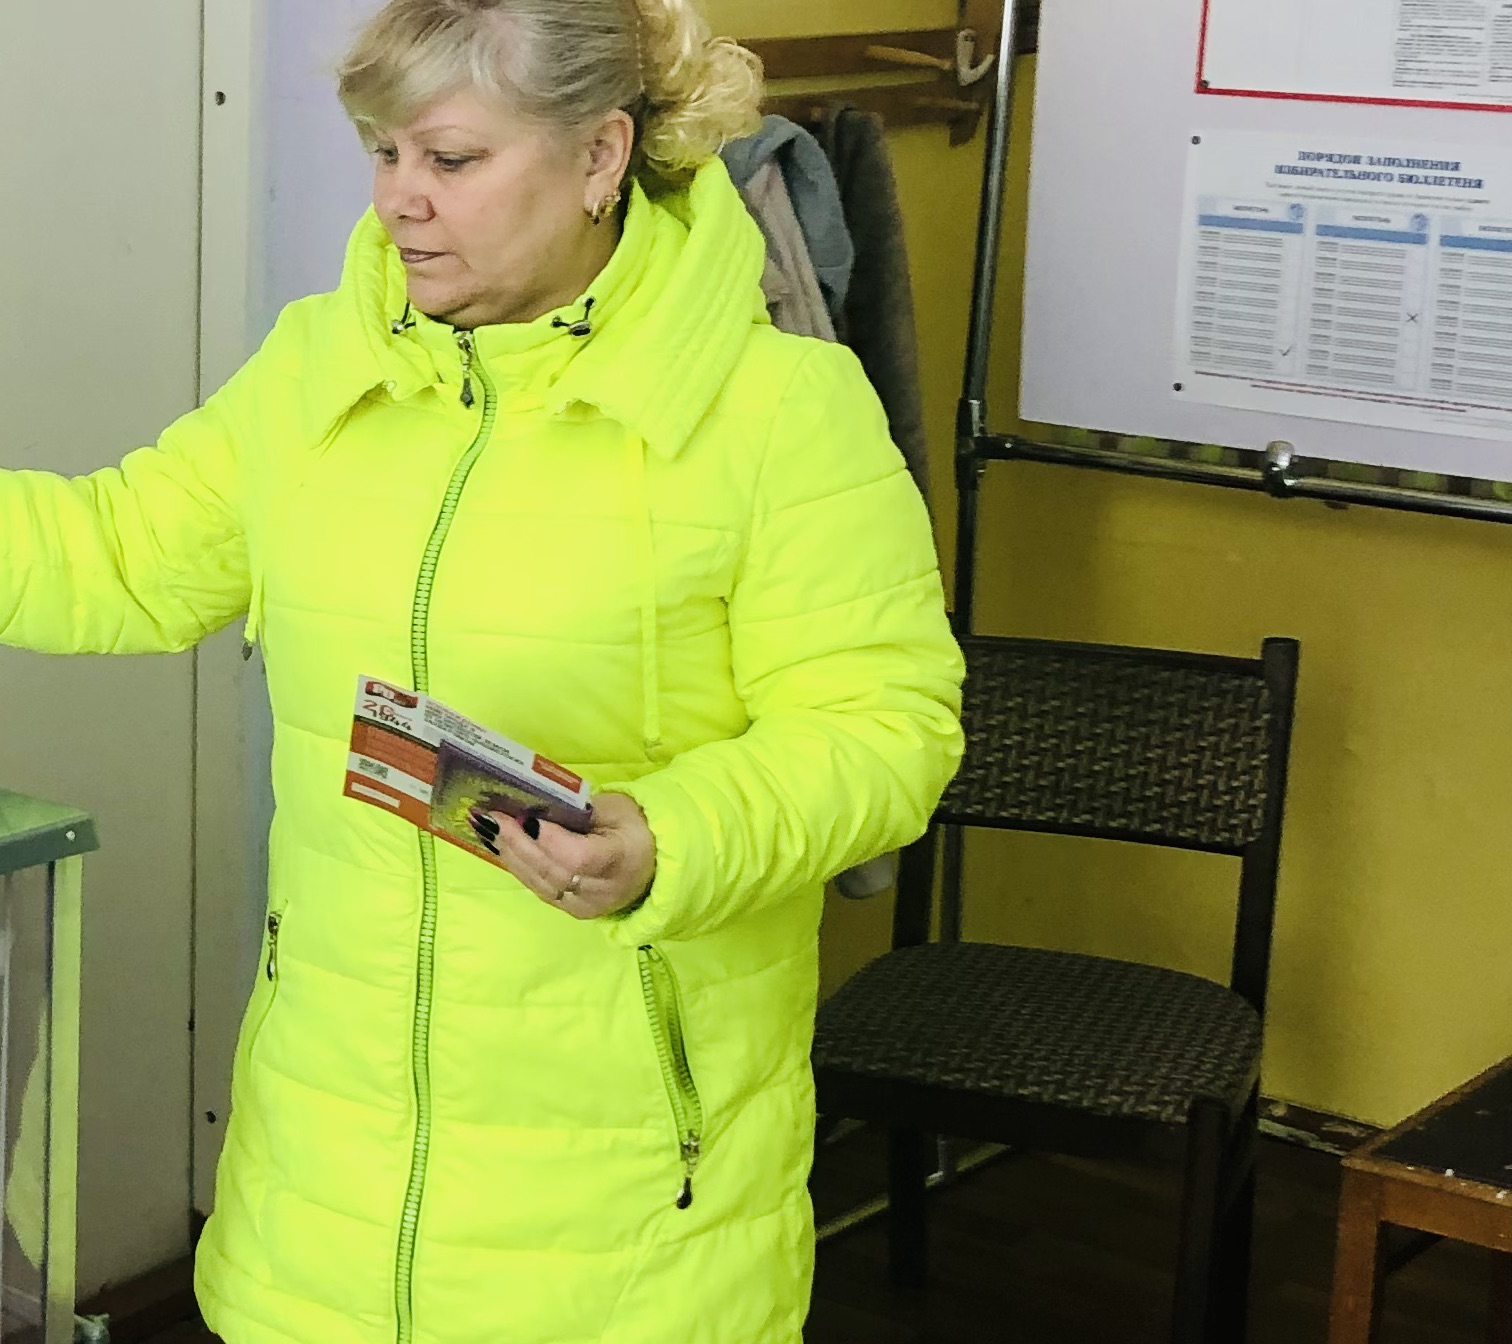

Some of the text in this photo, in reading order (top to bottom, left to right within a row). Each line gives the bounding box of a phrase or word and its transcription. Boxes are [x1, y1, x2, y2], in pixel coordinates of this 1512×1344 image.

[1297, 150, 1461, 172] ПОРЯДОК ЗАПОЛНЕНИЯ
[1274, 164, 1484, 189] ИЗБИРАТЕЛЬНОГО БЮЛЛЕТЕНЯ
